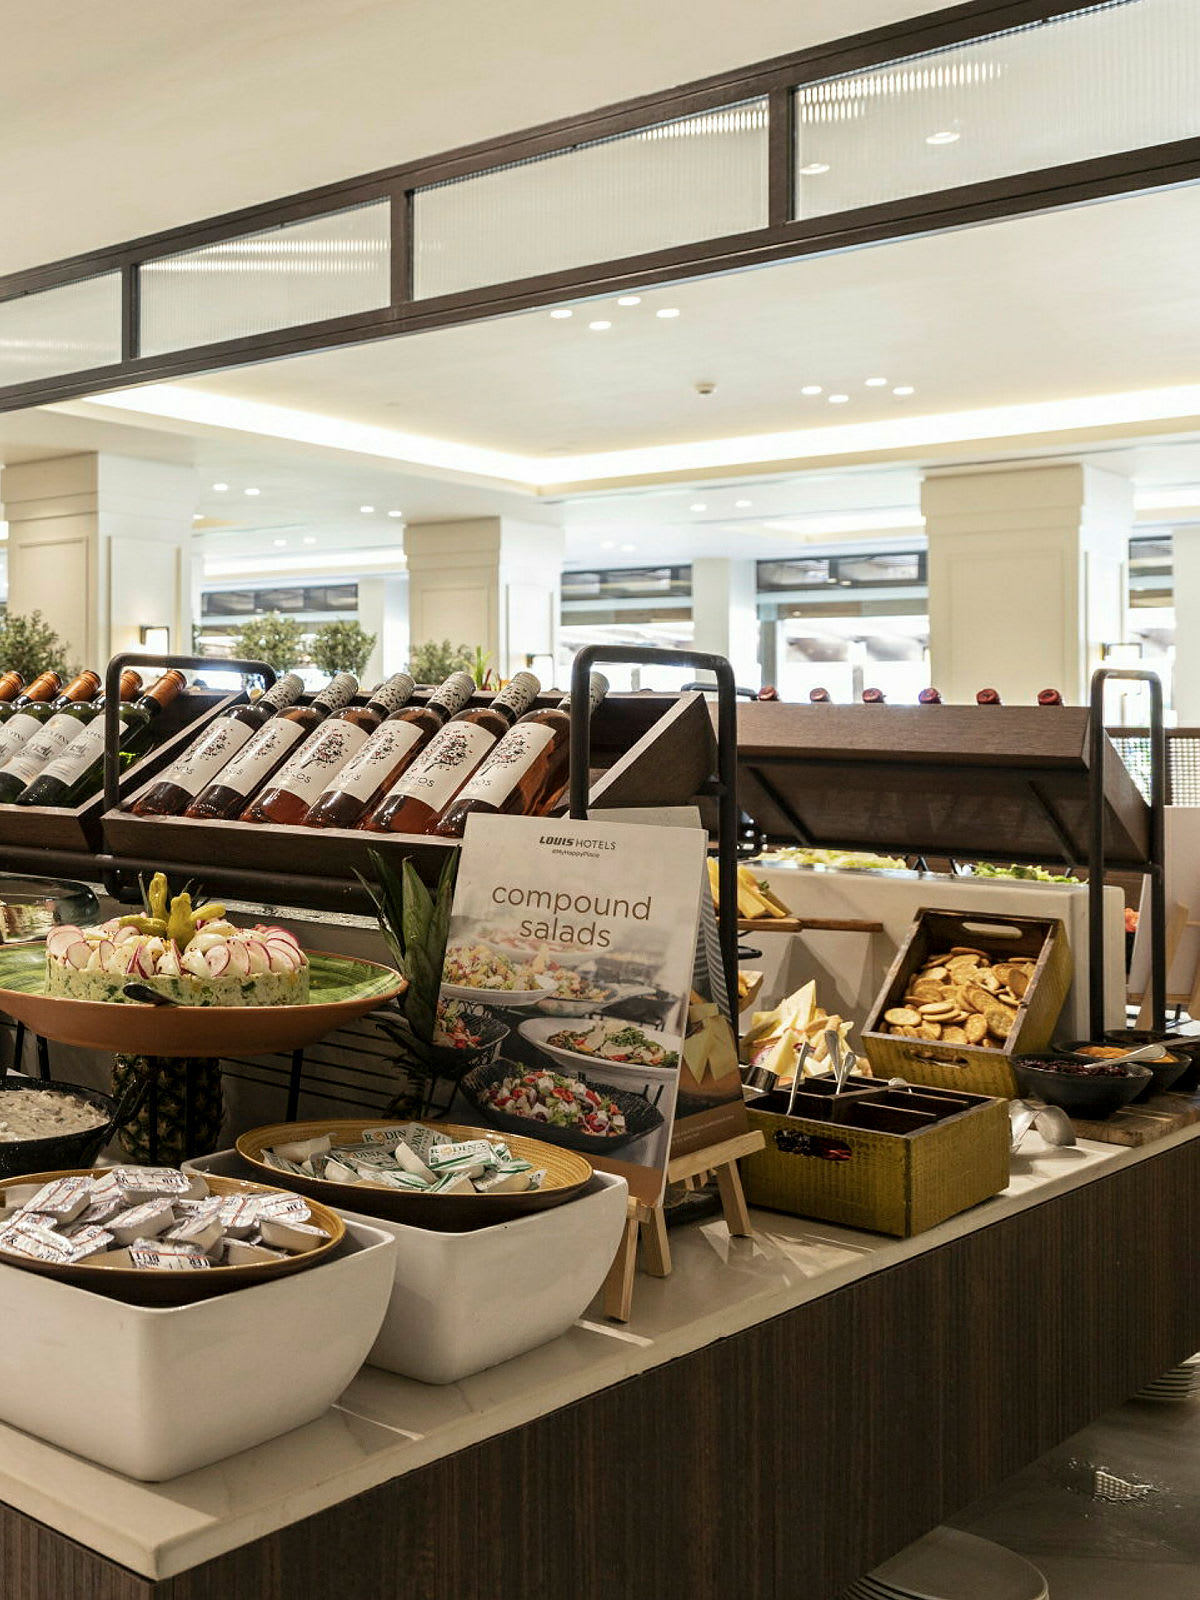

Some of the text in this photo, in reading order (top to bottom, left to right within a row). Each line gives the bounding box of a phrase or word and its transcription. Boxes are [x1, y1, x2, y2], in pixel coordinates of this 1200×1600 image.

[539, 836, 616, 850] LOUIS HOTELS
[492, 886, 651, 920] compound
[520, 918, 611, 948] salads
